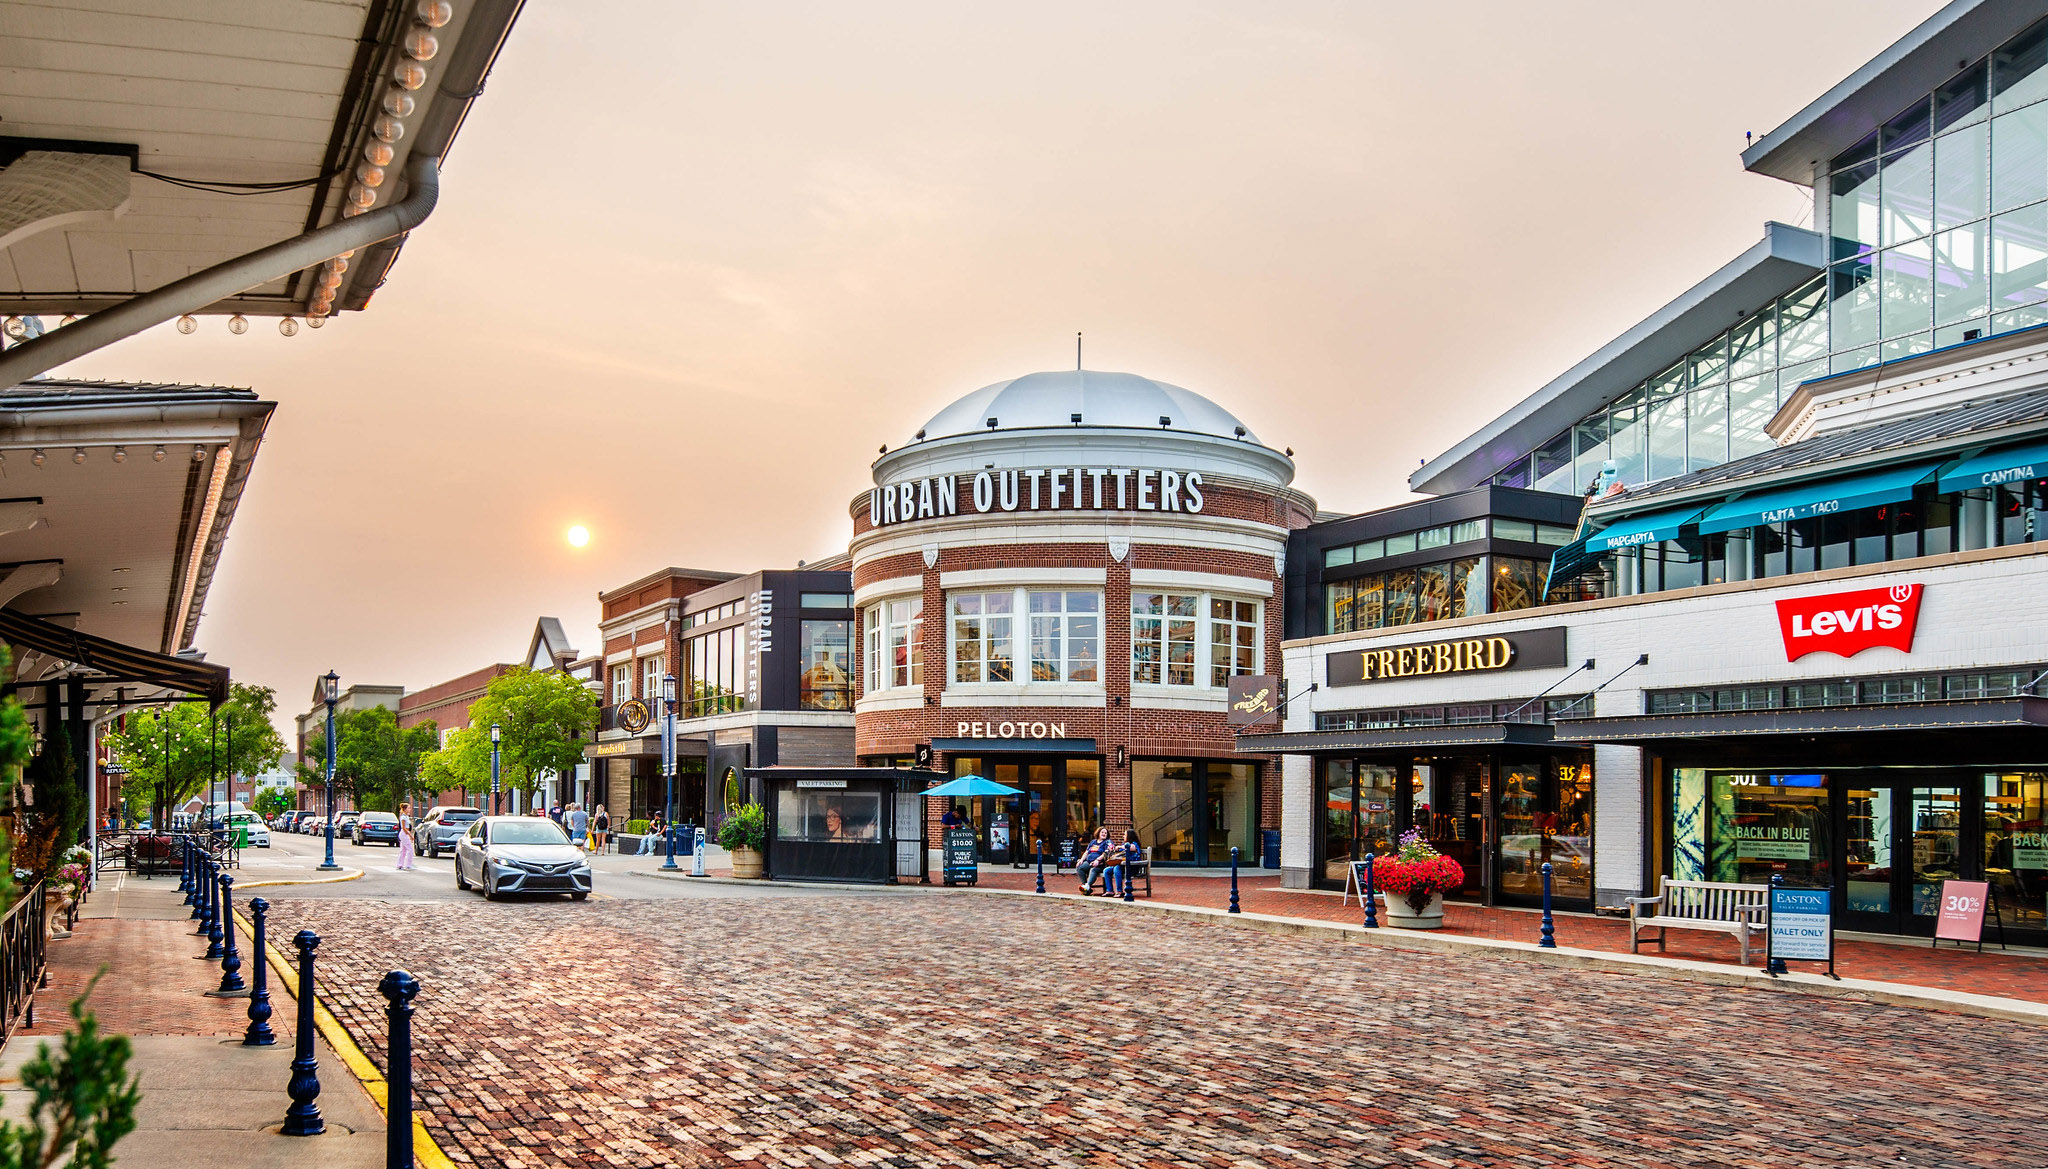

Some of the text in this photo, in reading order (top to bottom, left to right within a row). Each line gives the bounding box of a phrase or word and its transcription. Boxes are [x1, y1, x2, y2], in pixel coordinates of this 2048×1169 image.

[1982, 466, 2034, 485] CANTINA
[870, 468, 1204, 527] URBAN OUTFITTERS
[1761, 500, 1839, 523] FAJITA TACO
[1607, 532, 1655, 548] MARGARITA
[758, 590, 773, 652] URBAN
[749, 592, 759, 703] OUTFITTERS
[1361, 637, 1511, 680] FREEBIRD
[1234, 688, 1269, 710] FREEBIRD
[958, 721, 1065, 739] PELOTON
[1737, 826, 1810, 840] BACK IN BLUE
[2012, 832, 2048, 848] BACK
[1776, 893, 1822, 904] EASTON
[1772, 928, 1799, 936] VALET
